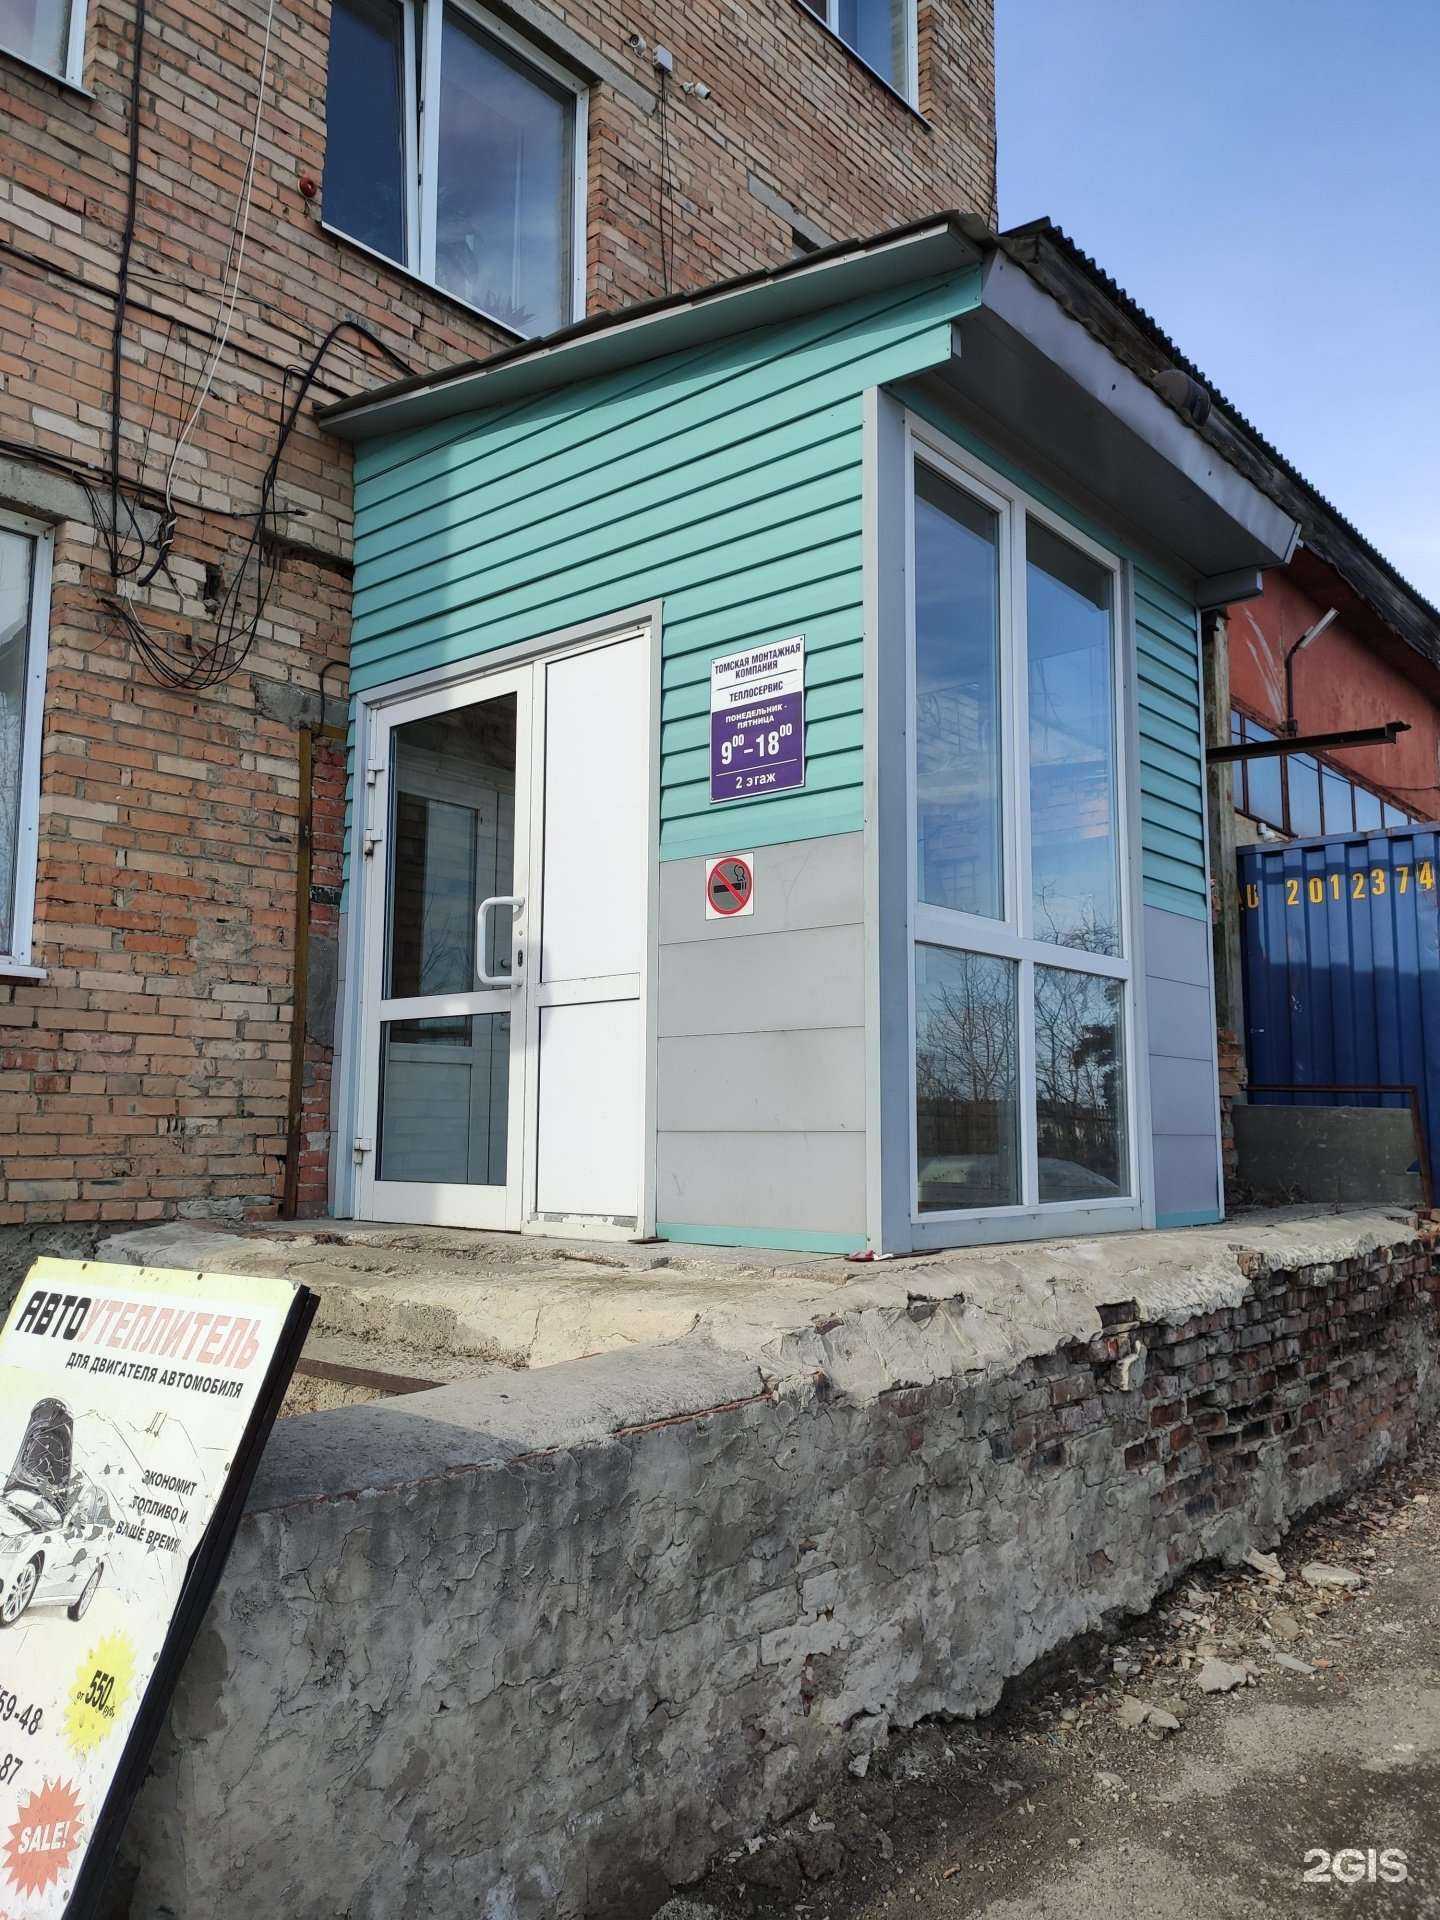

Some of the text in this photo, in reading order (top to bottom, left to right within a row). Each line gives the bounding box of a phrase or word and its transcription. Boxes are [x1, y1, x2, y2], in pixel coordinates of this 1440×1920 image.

[715, 643, 801, 675] ТОМСКАЯ МОНТАЖНАЯ
[735, 660, 778, 679] КОМПАНИЯ
[730, 680, 784, 703] ТЕПЛОСЕРВИС
[725, 705, 783, 723] ПОНЕДЕЛЬНИК
[737, 716, 775, 730] ПЯТНИЦА
[735, 771, 776, 790] 2 этаж
[15, 1290, 262, 1370] АВТОУТЕПЛИТЕЛЬ
[65, 1352, 244, 1399] ДЛЯ ДВИГАТЕЛЯ АВТОМОБИЛЯ
[142, 1469, 198, 1497] ЭКОНОМИТ
[132, 1495, 189, 1525] ТОПЛИВО И
[115, 1520, 146, 1542] ВАШЕ
[84, 1669, 115, 1712] 550
[18, 1822, 71, 1854] SALE!
